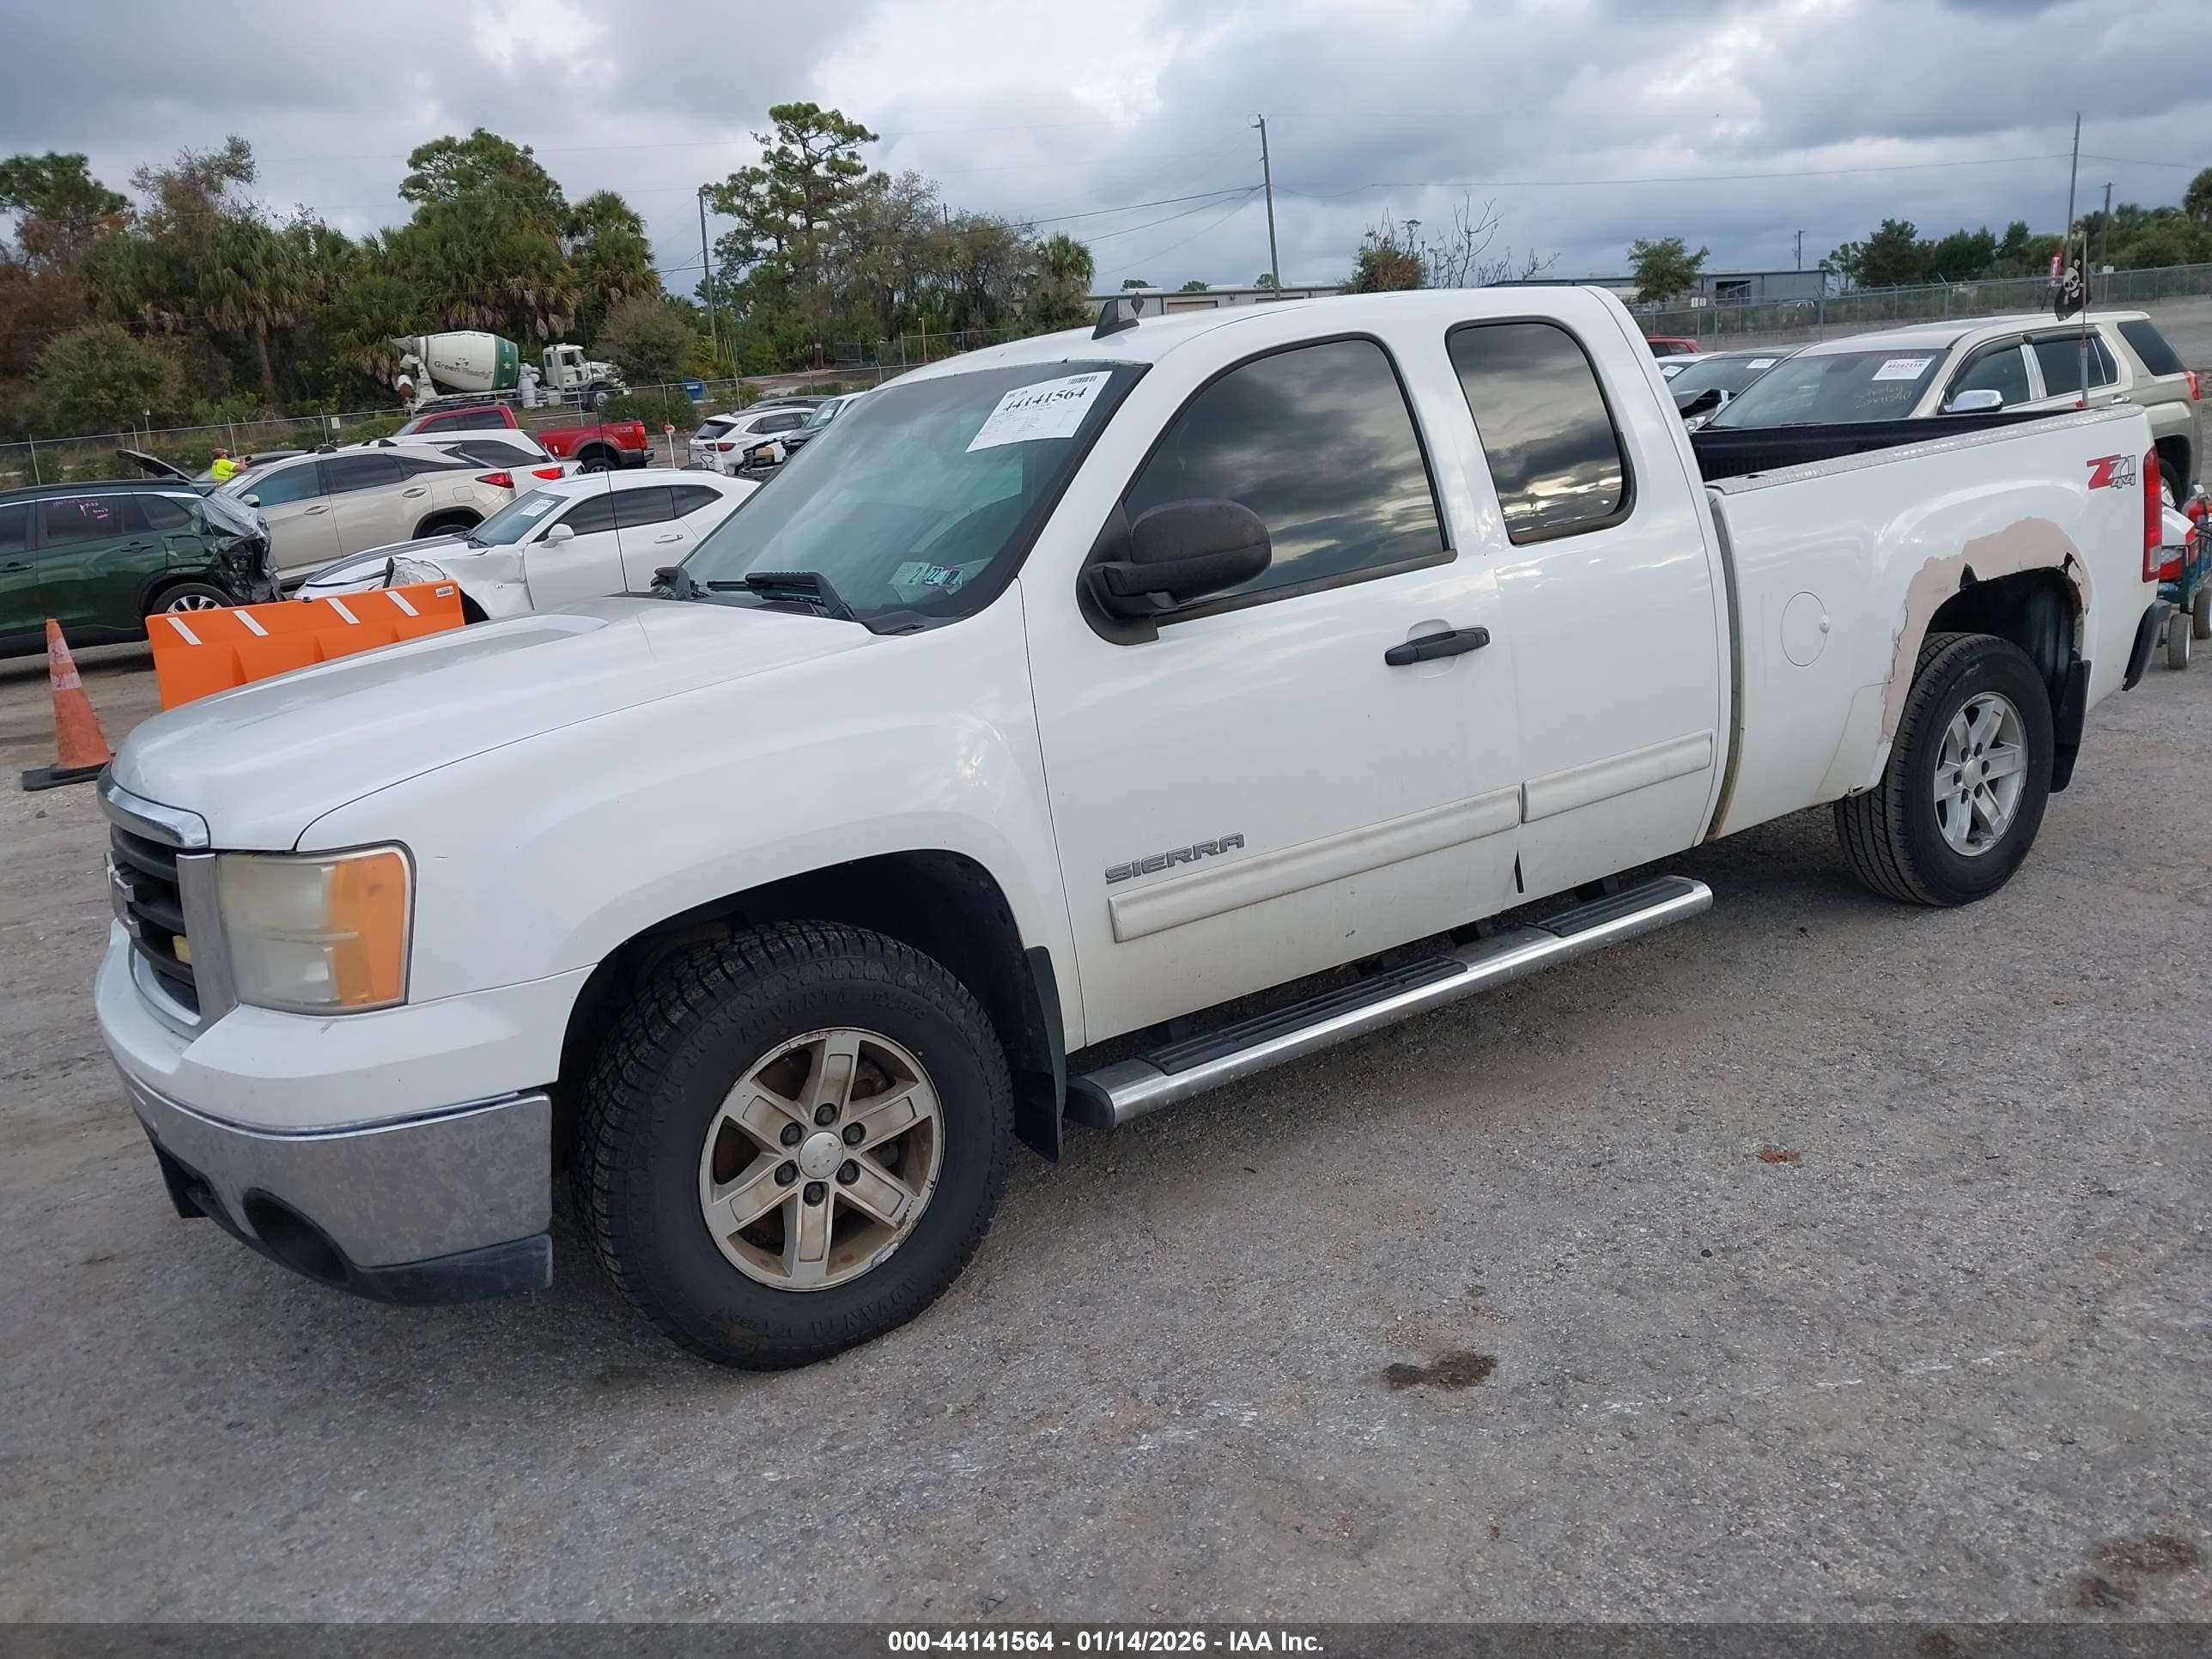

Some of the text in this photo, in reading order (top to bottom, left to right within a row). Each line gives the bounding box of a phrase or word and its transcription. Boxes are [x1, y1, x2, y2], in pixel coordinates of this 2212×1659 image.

[433, 360, 461, 374] Green
[1002, 386, 1089, 412] 44141564
[1104, 832, 1245, 885] SIERRA
